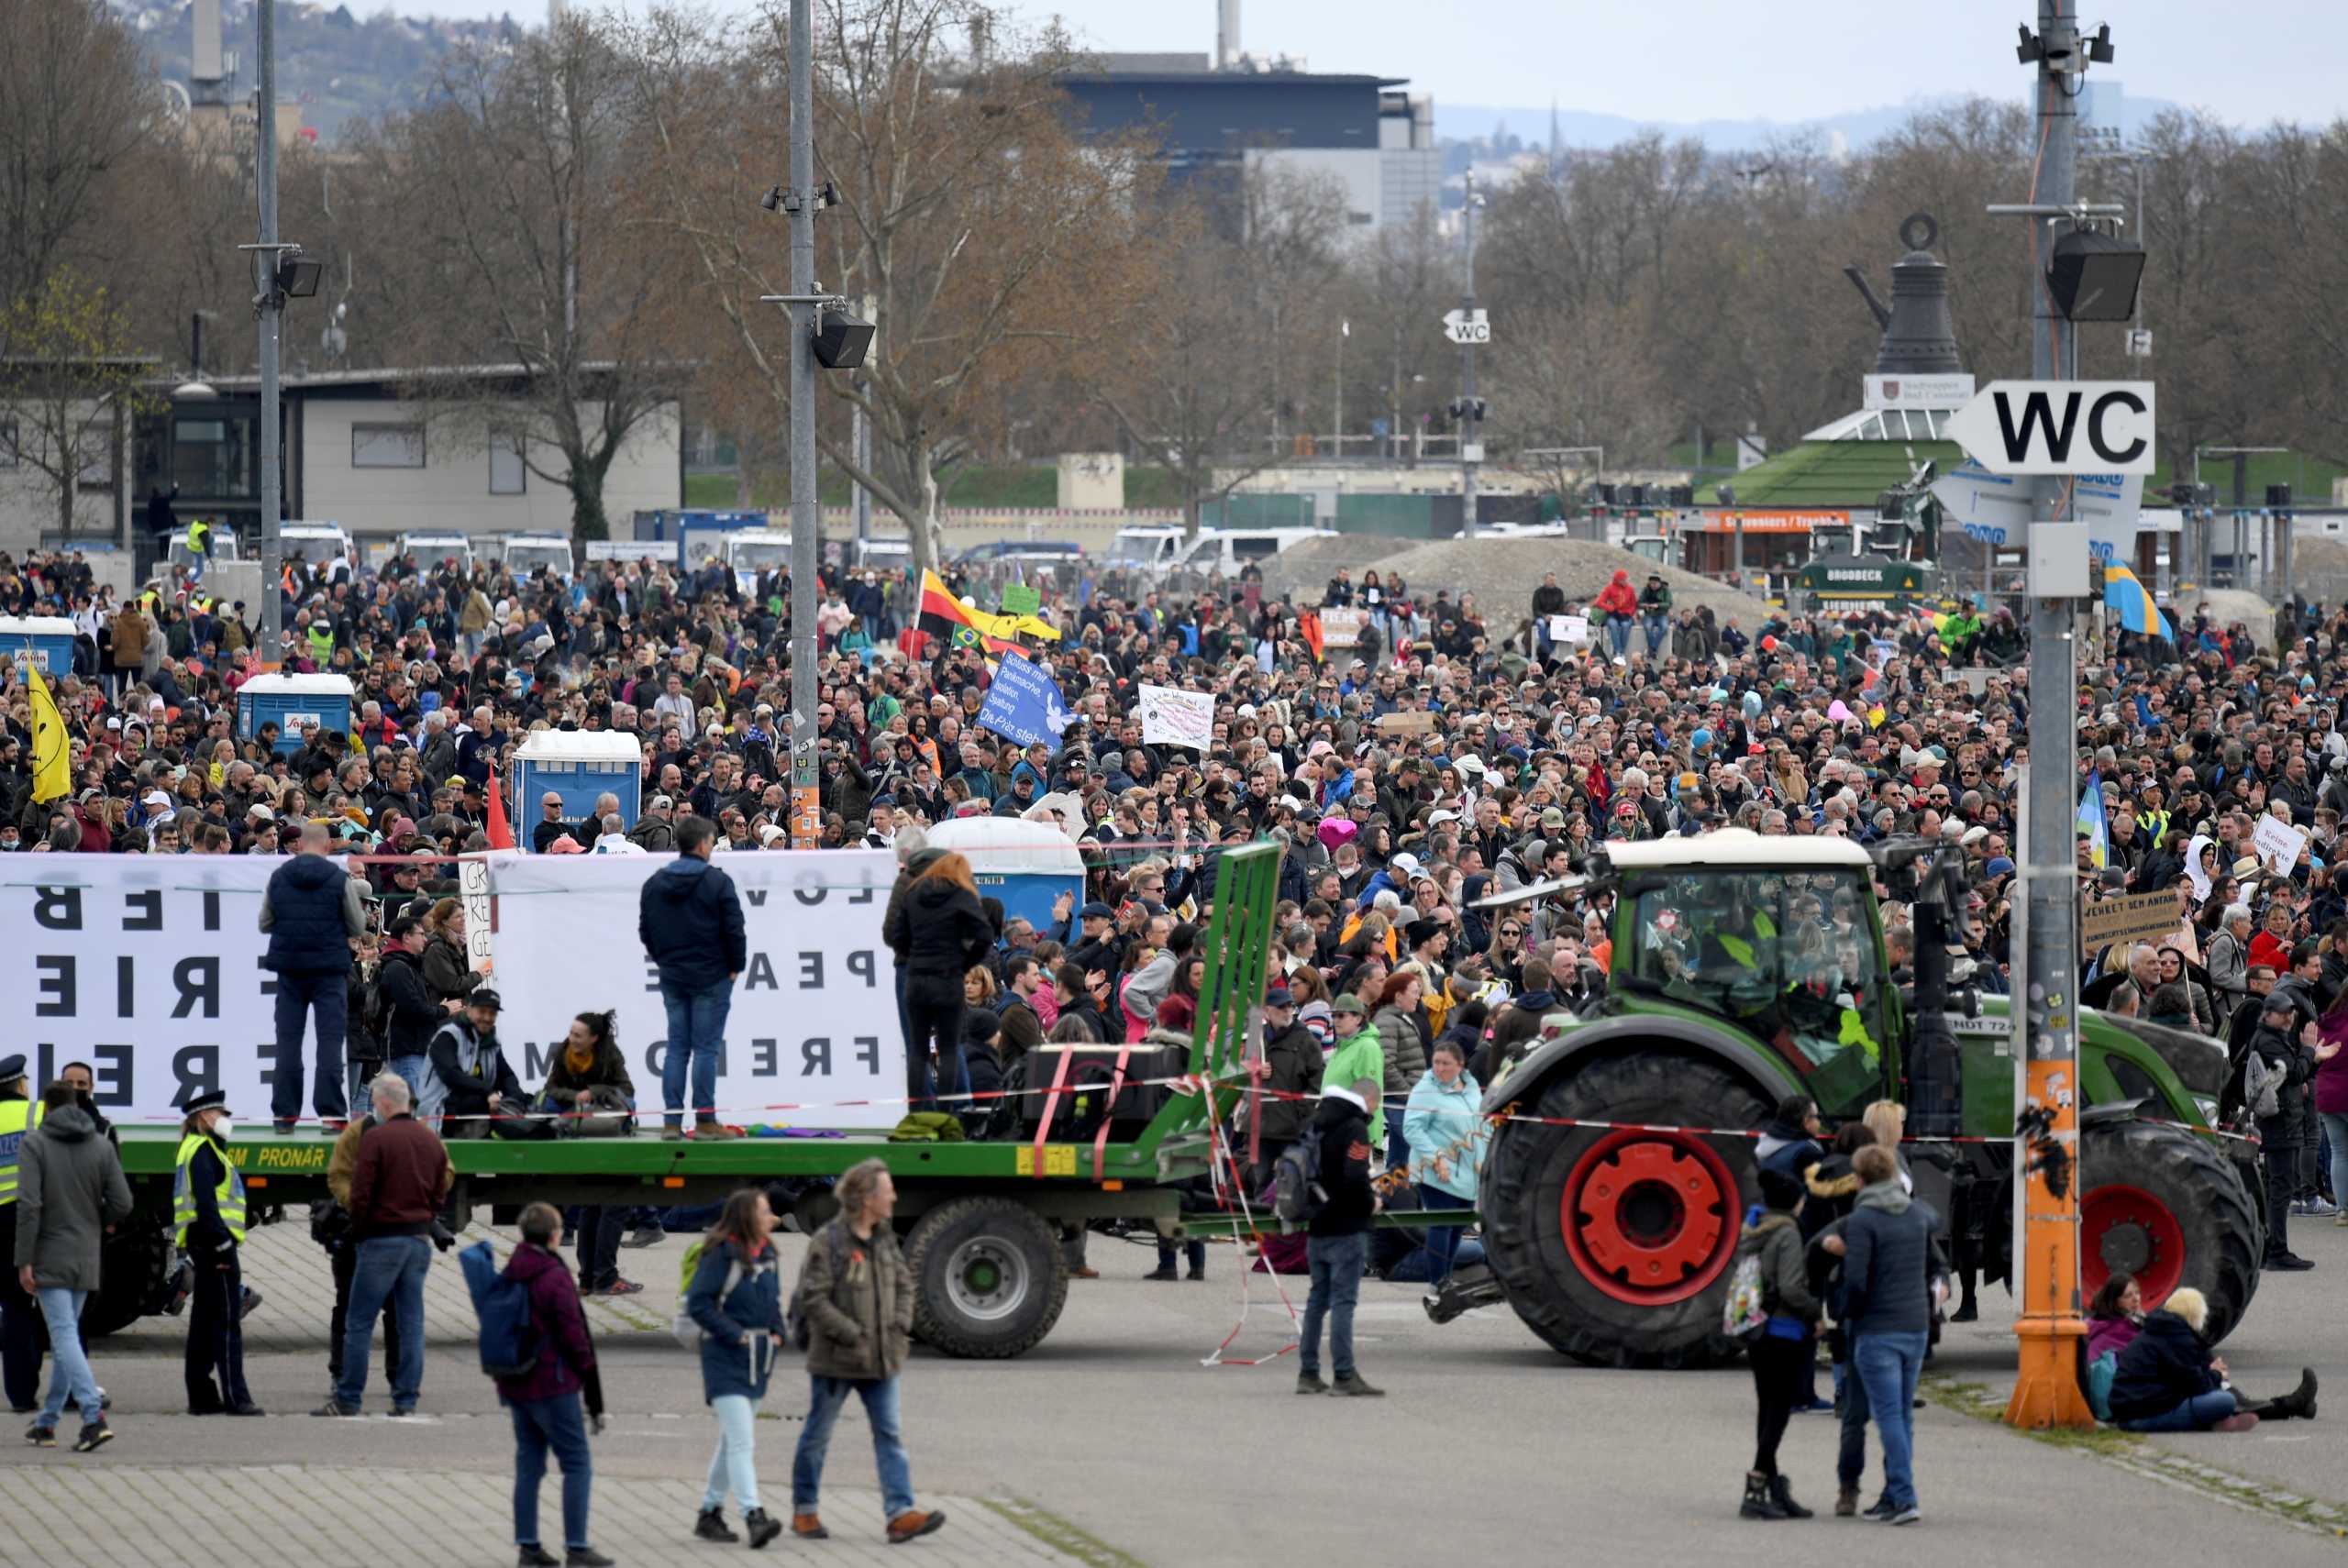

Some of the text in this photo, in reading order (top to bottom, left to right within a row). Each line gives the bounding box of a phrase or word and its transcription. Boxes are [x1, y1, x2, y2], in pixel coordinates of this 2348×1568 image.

[1456, 326, 1487, 340] WC
[1992, 391, 2148, 464] WC
[1827, 569, 1883, 581] BRODBECK
[1945, 1019, 1983, 1030] ENDT
[257, 1147, 325, 1167] PRONAR
